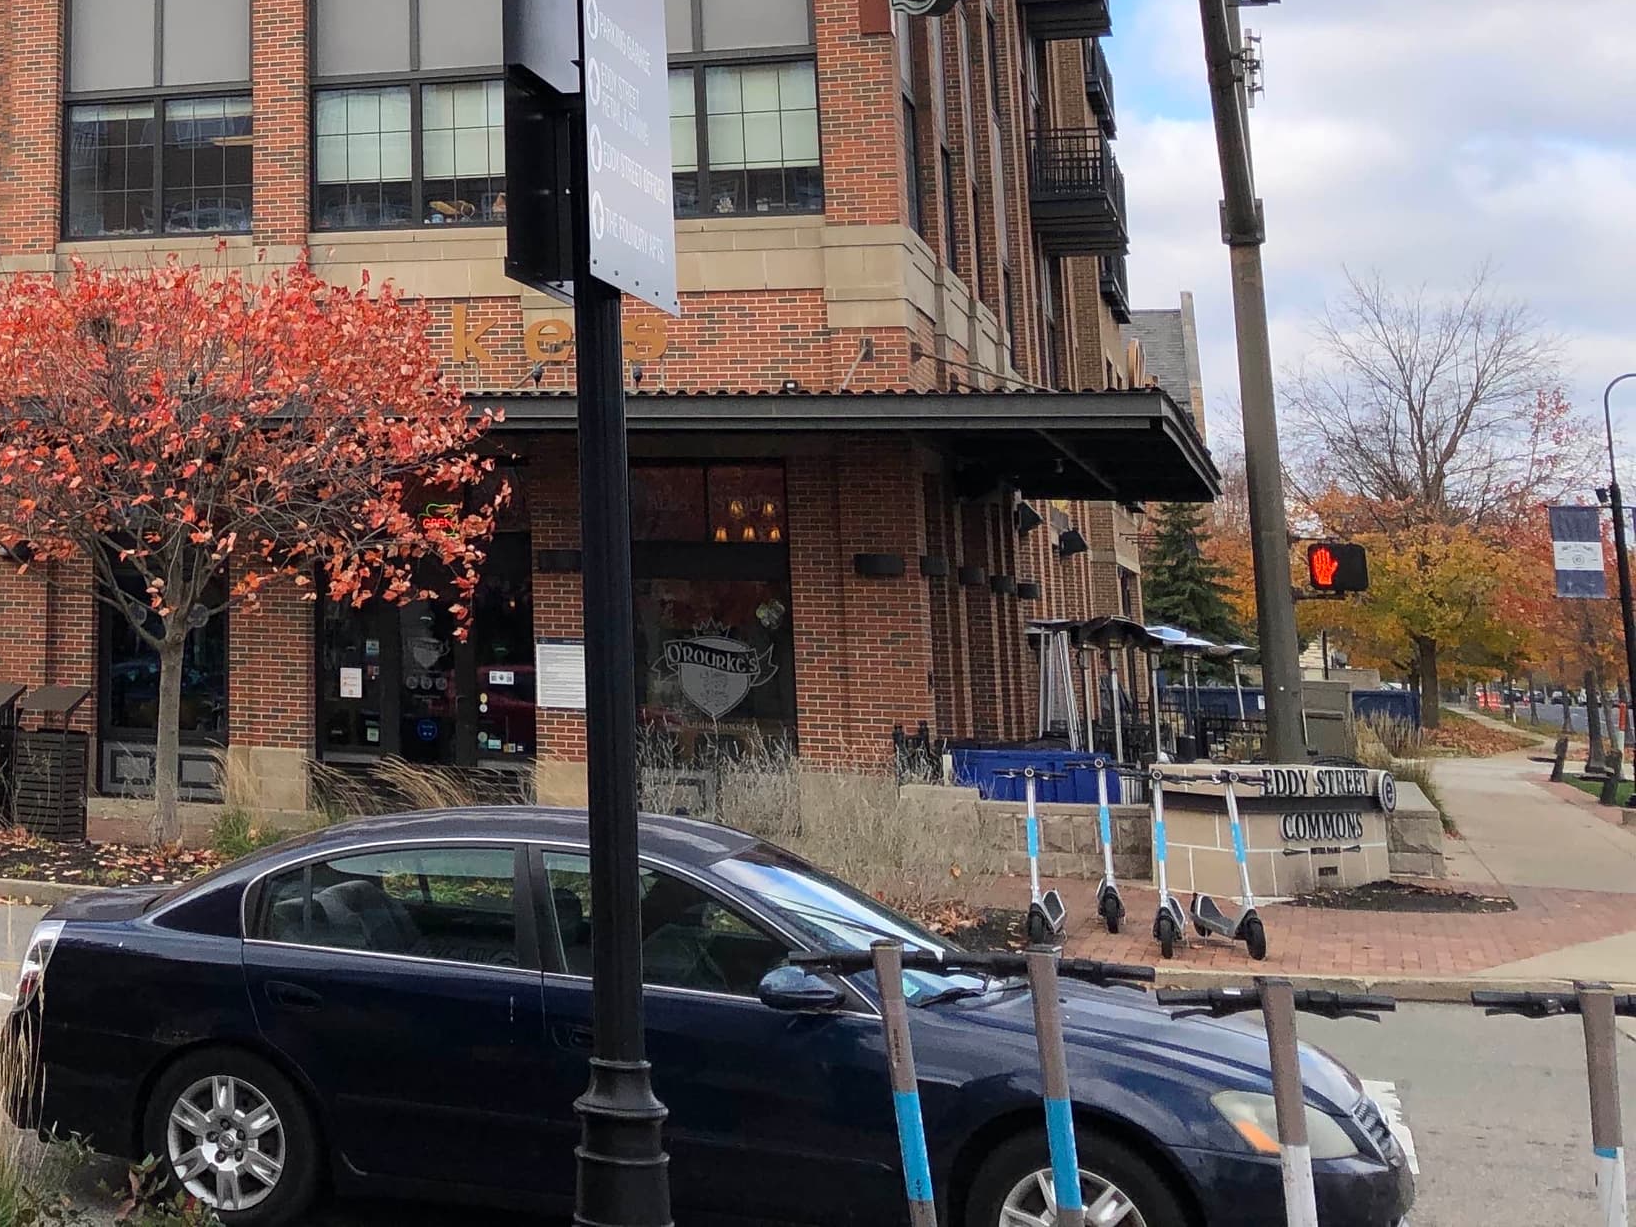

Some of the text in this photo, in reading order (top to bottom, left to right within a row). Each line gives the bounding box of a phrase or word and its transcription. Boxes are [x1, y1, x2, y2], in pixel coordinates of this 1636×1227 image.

[617, 73, 640, 113] STREET
[620, 152, 642, 190] STREET
[1260, 768, 1370, 796] EDDY STREET
[1280, 812, 1364, 841] COMMONS
